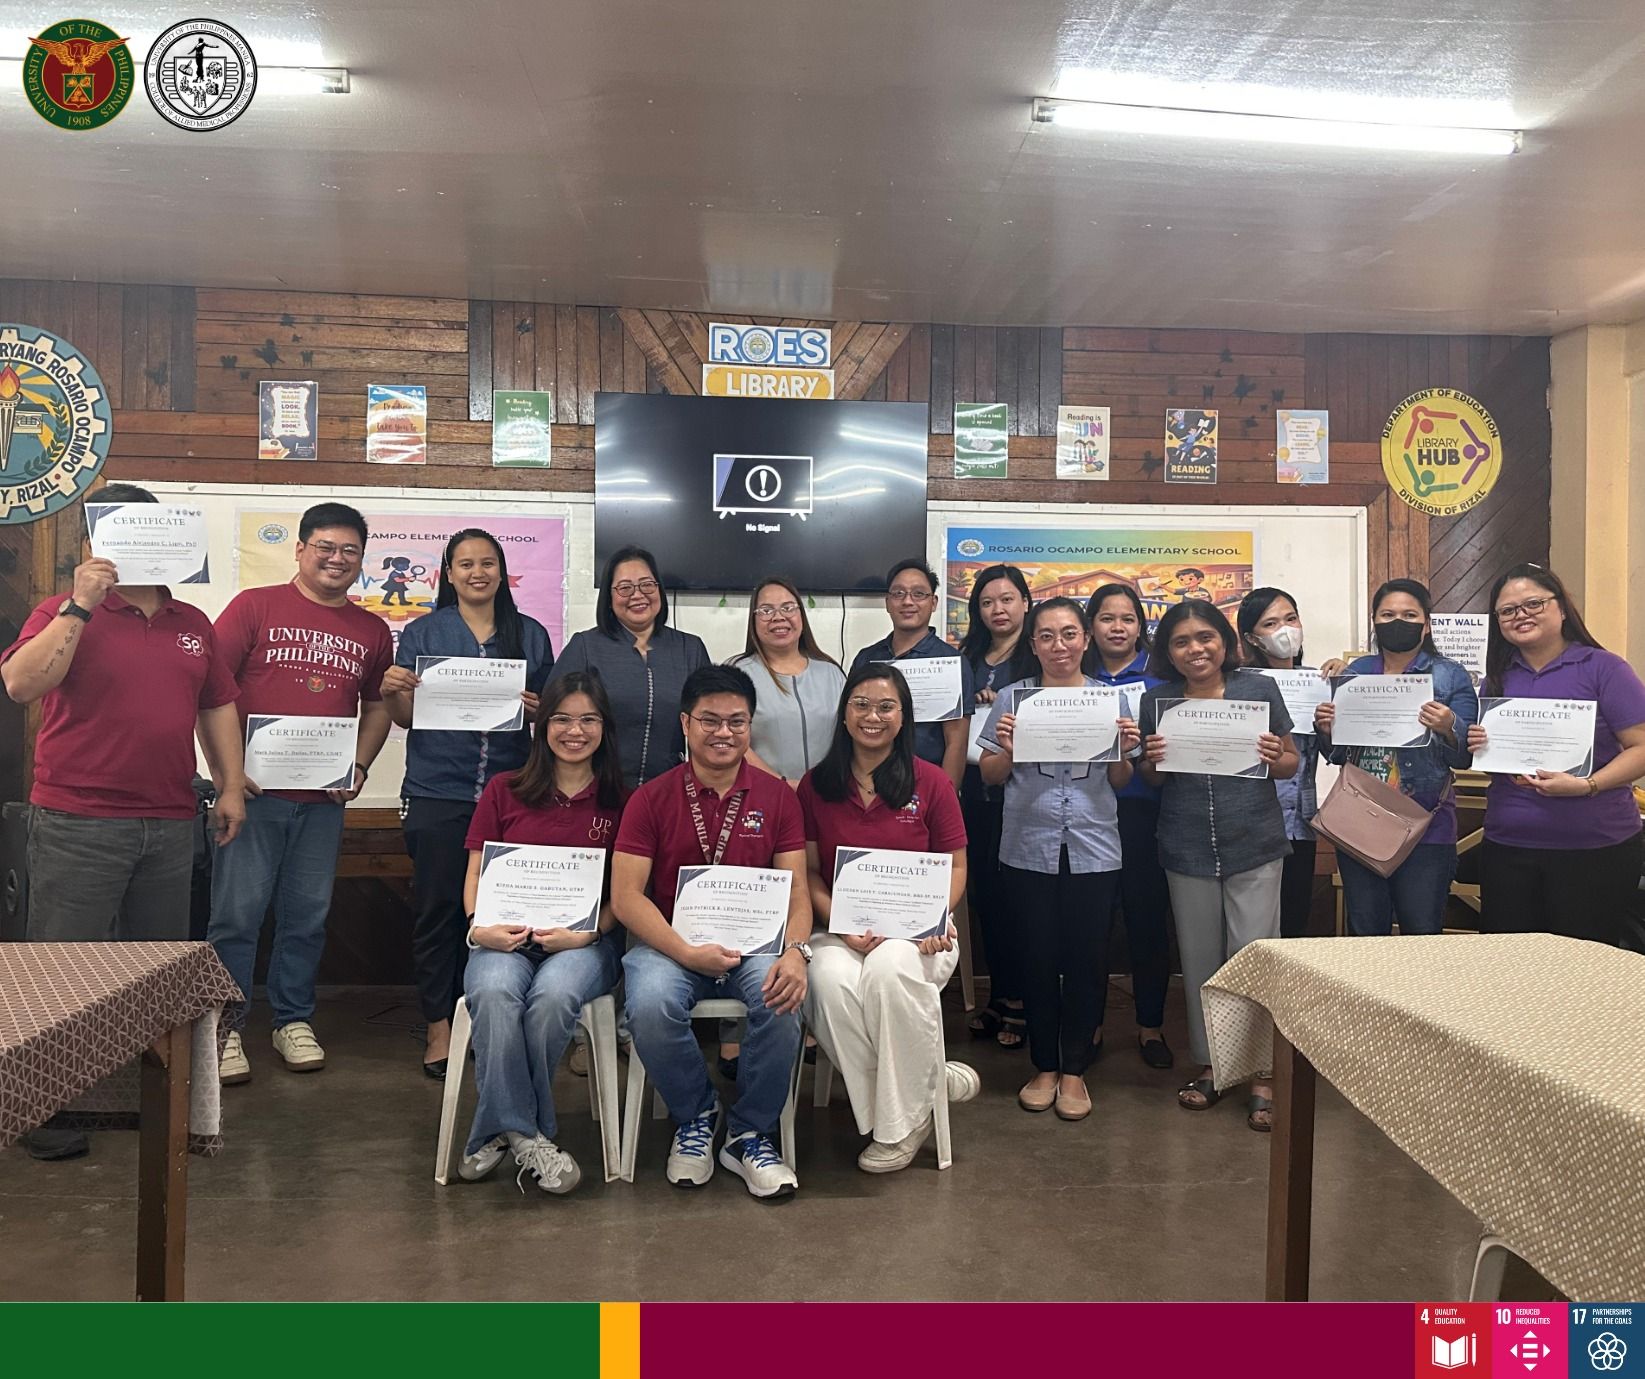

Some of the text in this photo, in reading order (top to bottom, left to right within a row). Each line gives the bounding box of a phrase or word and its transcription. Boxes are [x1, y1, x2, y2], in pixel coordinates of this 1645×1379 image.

[713, 326, 826, 365] ROES
[47, 361, 89, 412] ROSARIO
[726, 372, 819, 398] LIBRARY
[1067, 414, 1094, 422] Reading
[1382, 389, 1434, 438] DEPARTMENT
[1453, 390, 1499, 438] EDUCATION
[62, 417, 90, 473] OCAMPO
[1417, 438, 1459, 447] LIBRARY
[1418, 449, 1460, 466] HUB
[1171, 464, 1210, 474] READING
[17, 478, 59, 503] RIZAL
[1399, 488, 1486, 515] DIVISION OF RIZAL
[113, 516, 186, 526] CERTIFICATE
[757, 524, 780, 533] Signal
[989, 545, 1241, 556] ROSARIO OCAMPO ELEMENTARY SCHOOL
[269, 628, 368, 660] UNIVERSITY
[266, 648, 364, 679] PHILIPPINES
[438, 668, 505, 678] CERTIFICATE
[1033, 699, 1098, 707] CERTIFICATE
[1178, 710, 1247, 720] CERTIFICATE
[1499, 709, 1571, 720] CERTIFICATE
[269, 729, 336, 737] CERTIFICATE
[592, 816, 612, 829] UP
[686, 782, 710, 852] UP MANILA
[506, 859, 580, 870] CERTIFICATE
[857, 864, 928, 876] CERTIFICATE
[697, 881, 767, 892] CERTIFICATE
